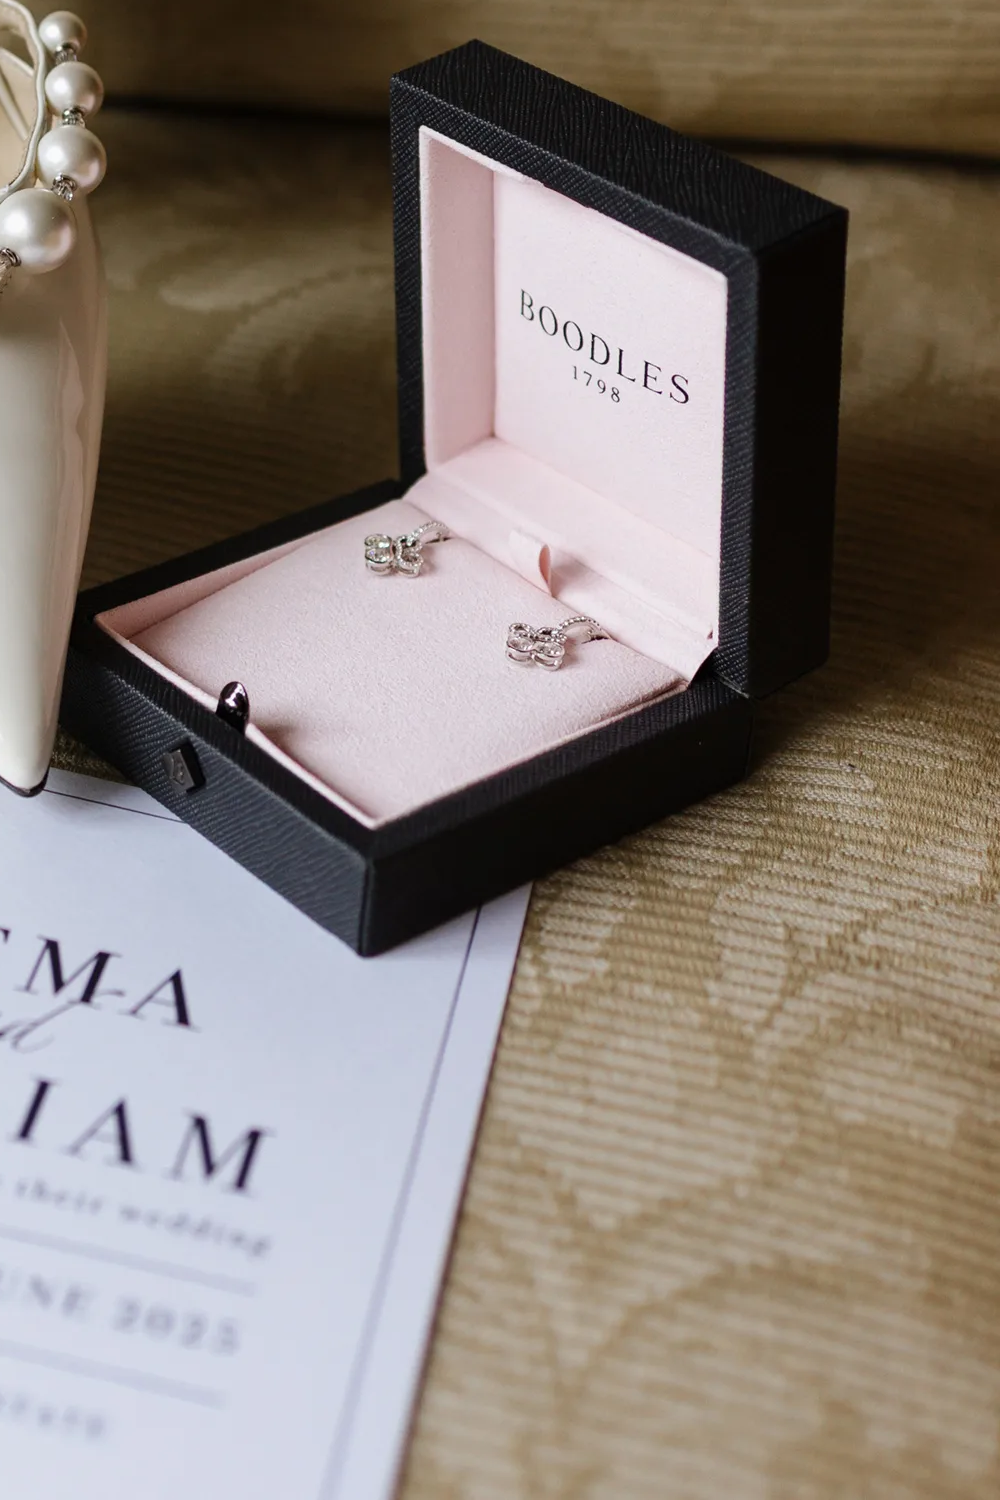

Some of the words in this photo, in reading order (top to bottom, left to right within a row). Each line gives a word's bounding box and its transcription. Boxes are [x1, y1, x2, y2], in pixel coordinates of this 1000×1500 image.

[520, 288, 690, 405] BOODLES
[572, 365, 621, 404] 1798
[13, 1176, 103, 1216] their
[118, 1204, 272, 1258] wedding
